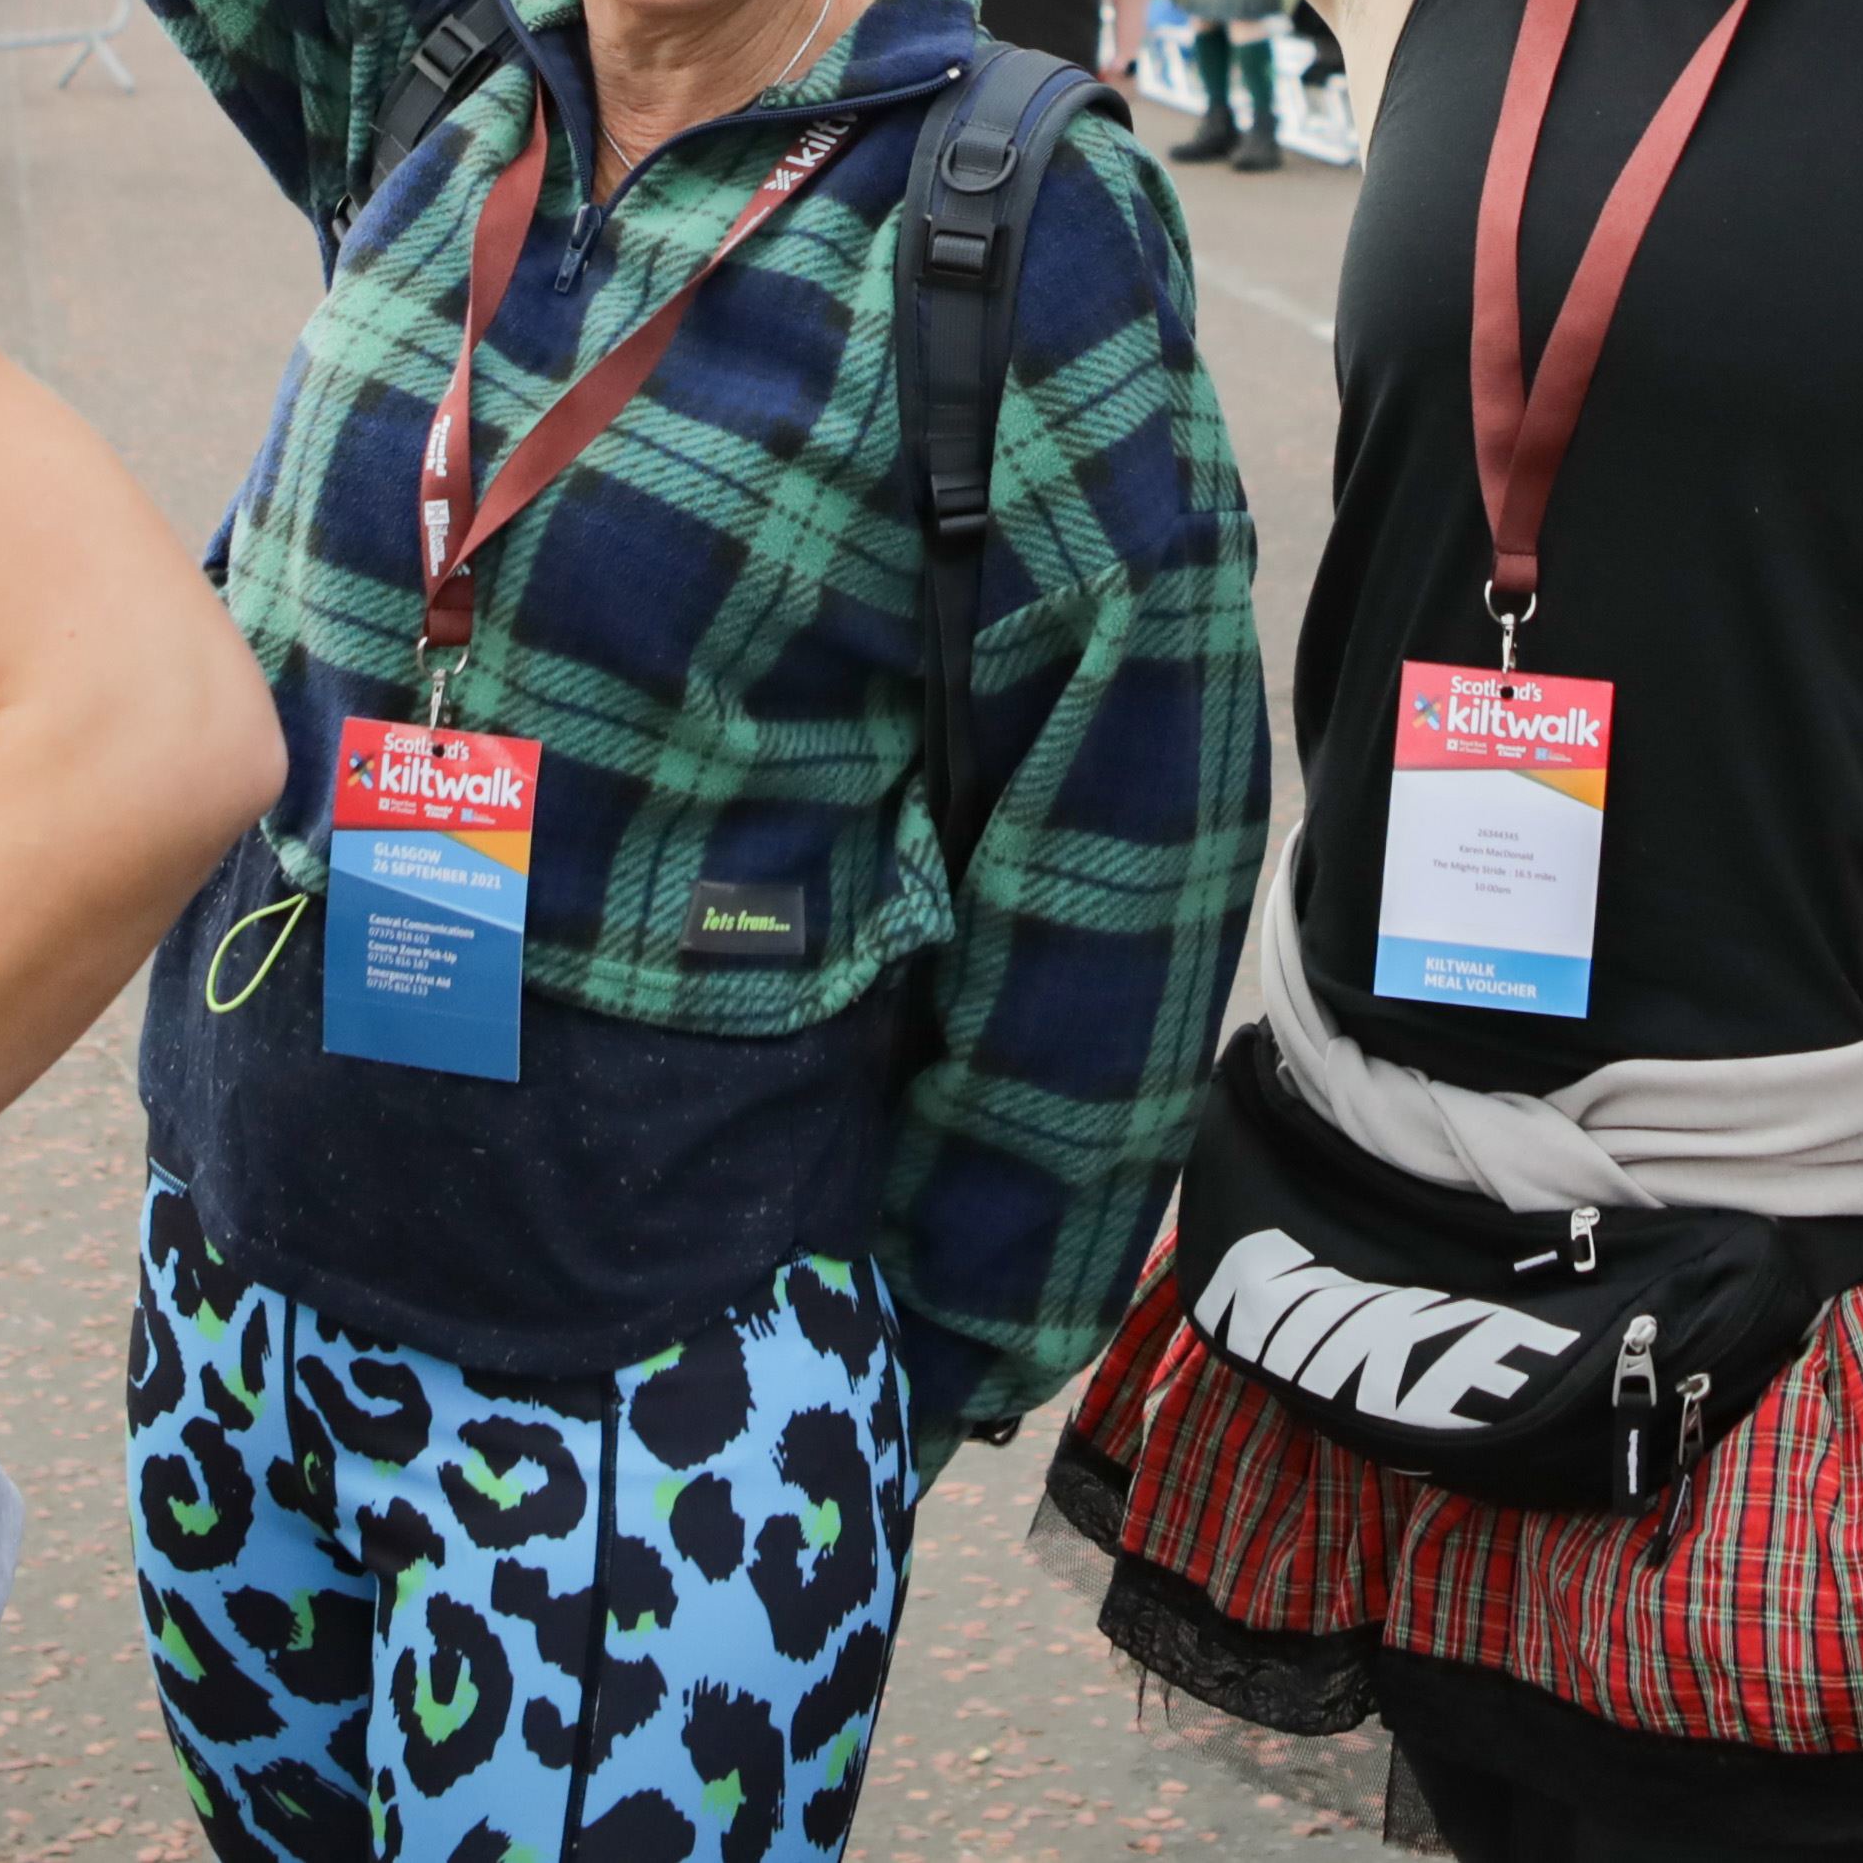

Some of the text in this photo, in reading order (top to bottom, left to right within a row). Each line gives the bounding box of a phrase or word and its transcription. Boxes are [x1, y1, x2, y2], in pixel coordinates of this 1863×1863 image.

[1447, 695, 1601, 747] kiltwalk
[379, 753, 524, 809] kiltwalk
[374, 842, 442, 864] GLASGOW
[373, 859, 502, 889] 26 SEPTEMBER 2021
[1425, 956, 1495, 978] KILTWALK
[1424, 973, 1537, 999] MEAL VOUCHER
[1194, 1228, 1581, 1430] NIKE
